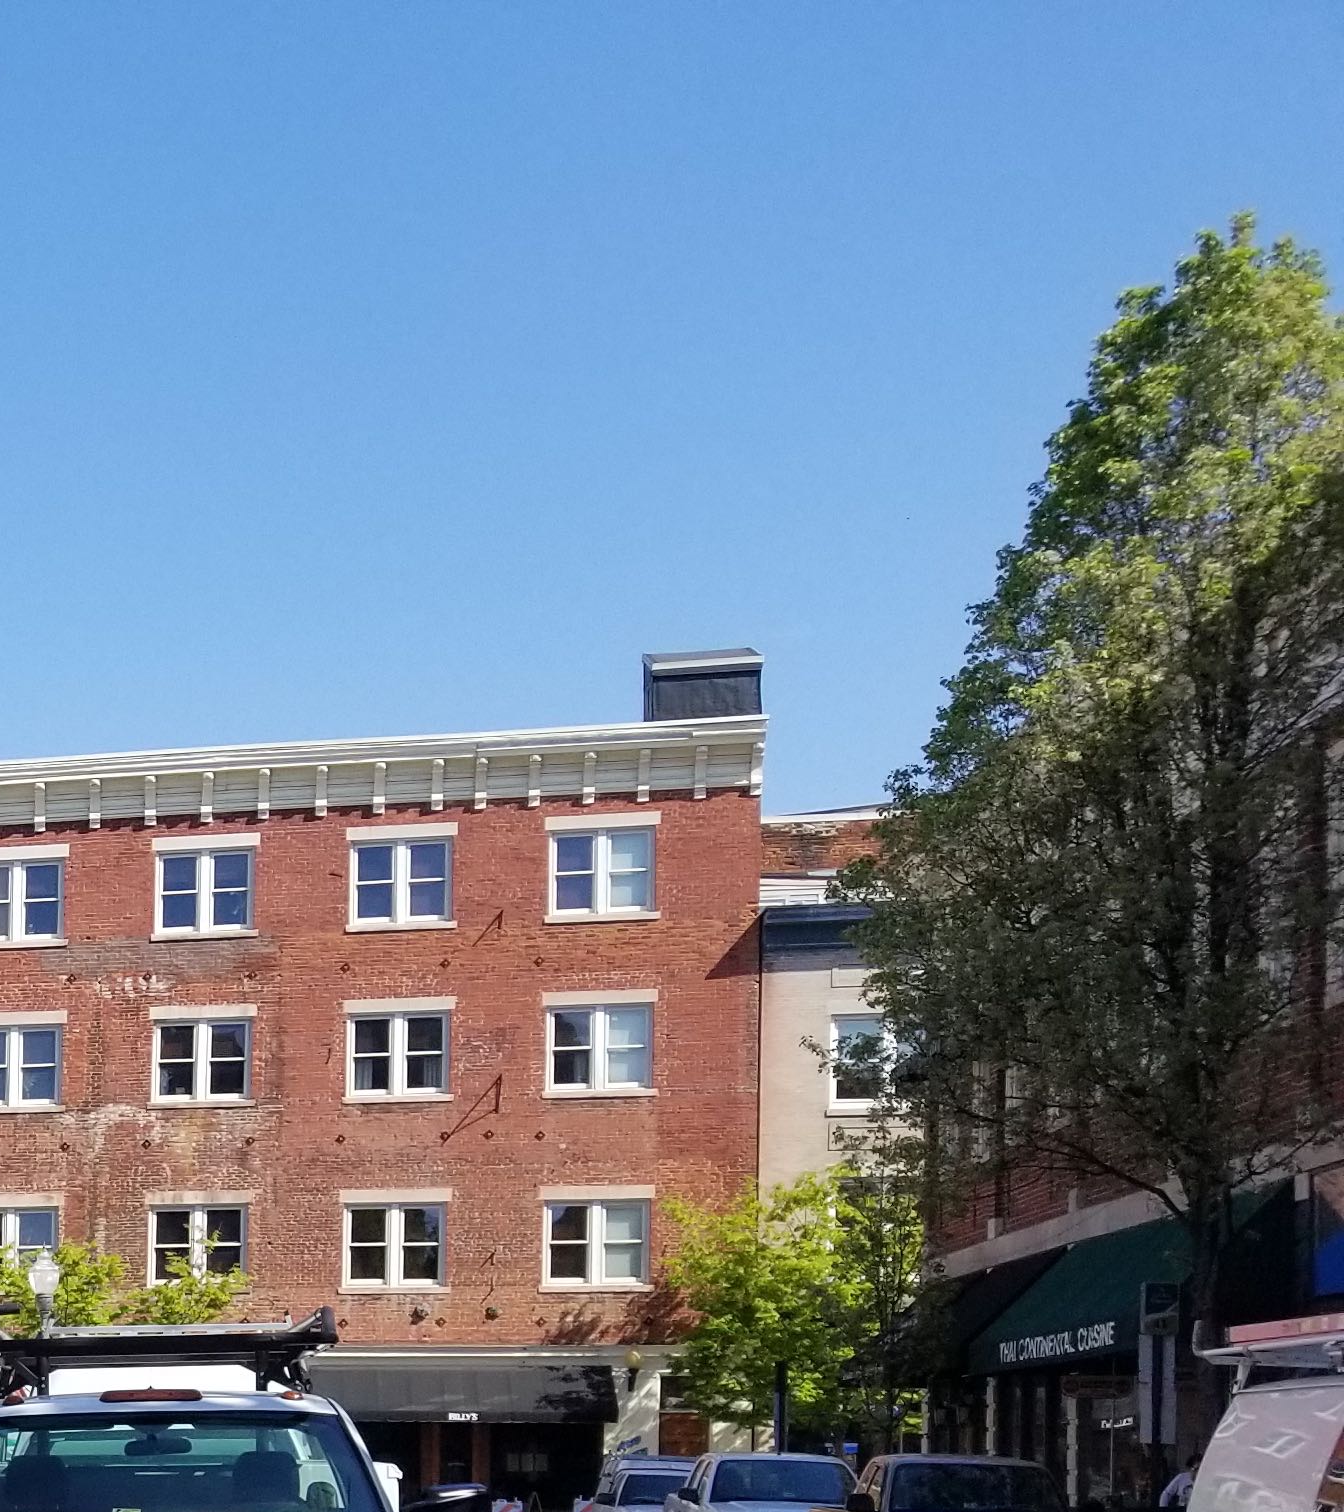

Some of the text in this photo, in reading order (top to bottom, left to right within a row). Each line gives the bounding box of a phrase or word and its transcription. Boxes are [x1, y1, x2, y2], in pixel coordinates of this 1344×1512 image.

[999, 1321, 1115, 1363] THAI CONTINENTAL CUISINE
